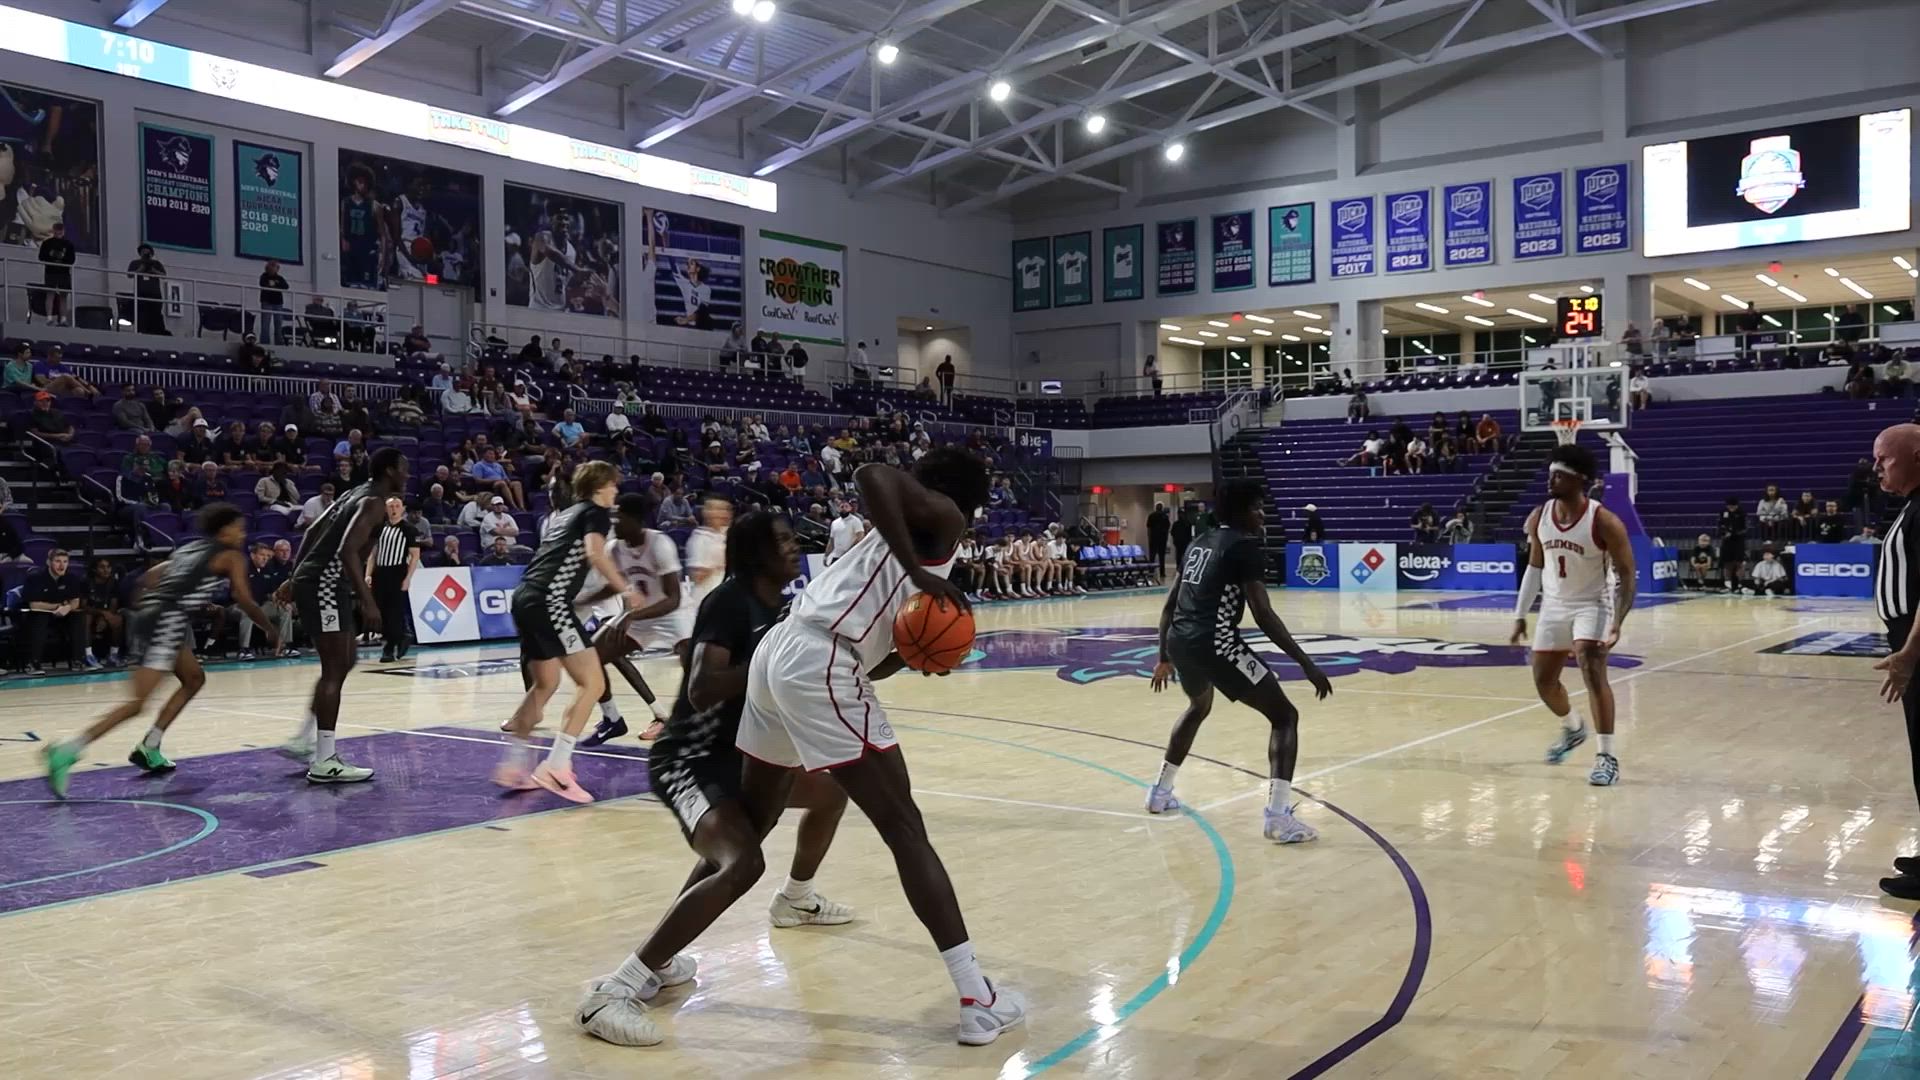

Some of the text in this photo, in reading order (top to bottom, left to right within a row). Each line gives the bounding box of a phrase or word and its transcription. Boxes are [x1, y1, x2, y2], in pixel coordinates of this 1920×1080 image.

[100, 31, 154, 64] 7:10
[430, 110, 510, 144] TAKE TWO
[570, 141, 639, 172] TAKE TWO
[168, 171, 208, 185] BASKETBALL
[147, 183, 209, 203] CHAMPIONS
[147, 196, 210, 215] 2018 2019 2020
[241, 209, 298, 227] 2018 2019
[241, 220, 269, 232] 2020
[1520, 239, 1557, 254] 2023
[1583, 232, 1621, 248] 2025
[1392, 254, 1422, 267] 2021
[1450, 246, 1485, 260] 2022
[759, 257, 841, 288] CROWTHER
[1337, 262, 1368, 275] 2017
[765, 279, 833, 305] ROOFING
[1565, 312, 1594, 335] 24
[1181, 546, 1212, 585] 21
[1399, 552, 1451, 569] alexa+
[1456, 561, 1515, 573] GEICO
[1558, 555, 1567, 578] 1
[1797, 562, 1871, 577] GEICO
